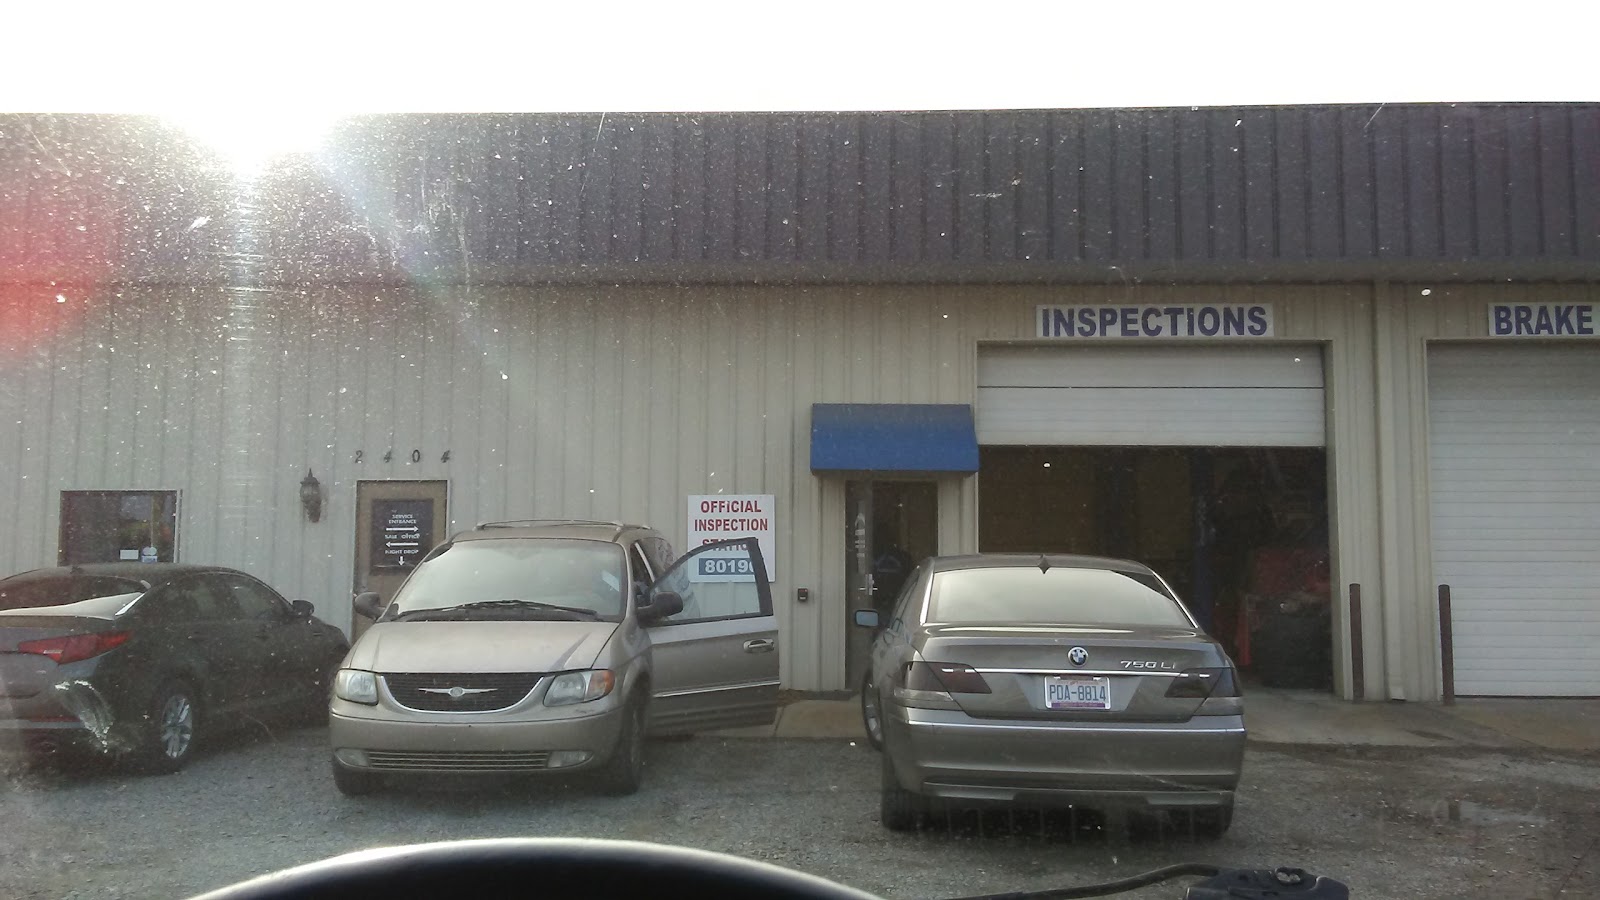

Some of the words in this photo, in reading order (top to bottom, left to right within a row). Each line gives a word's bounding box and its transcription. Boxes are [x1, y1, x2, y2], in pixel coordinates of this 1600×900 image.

[1042, 306, 1267, 337] INSPECTIONS
[1494, 305, 1594, 335] BRAKE
[700, 500, 762, 513] OFFICIAL
[694, 518, 768, 532] INSPECTION
[1120, 660, 1157, 668] 750
[1049, 684, 1106, 701] PDA-8814
